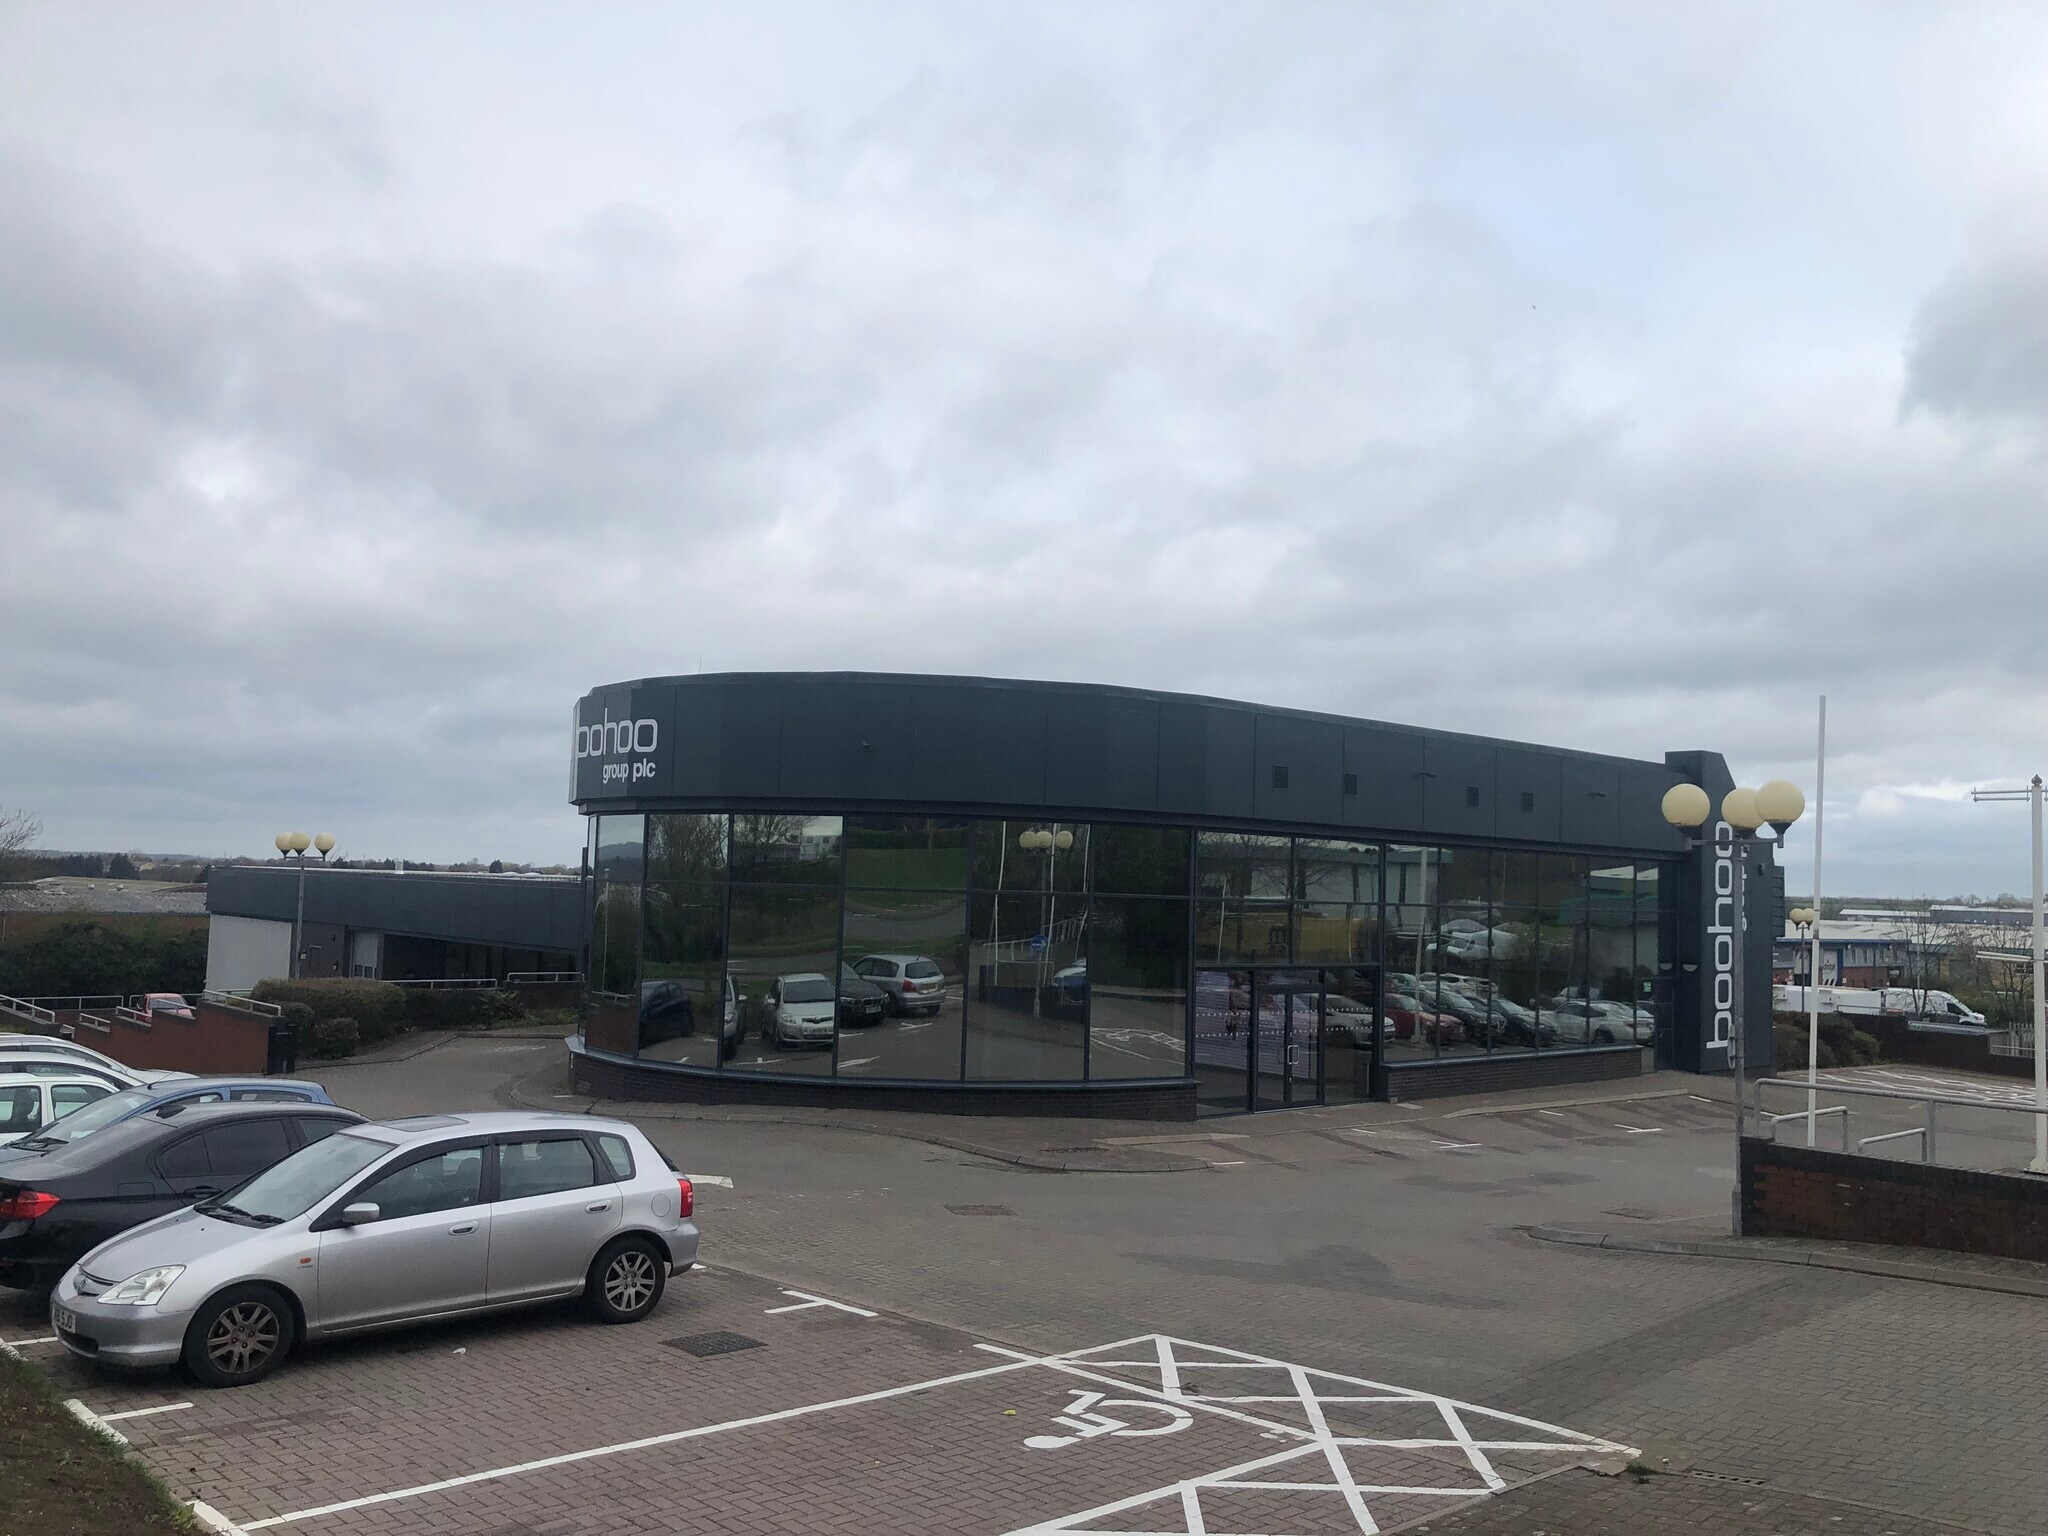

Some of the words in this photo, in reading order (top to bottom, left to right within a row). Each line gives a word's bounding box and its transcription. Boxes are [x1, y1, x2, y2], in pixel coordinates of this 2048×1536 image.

[603, 763, 629, 784] group
[633, 758, 656, 782] plc
[1706, 821, 1732, 1049] boohoo
